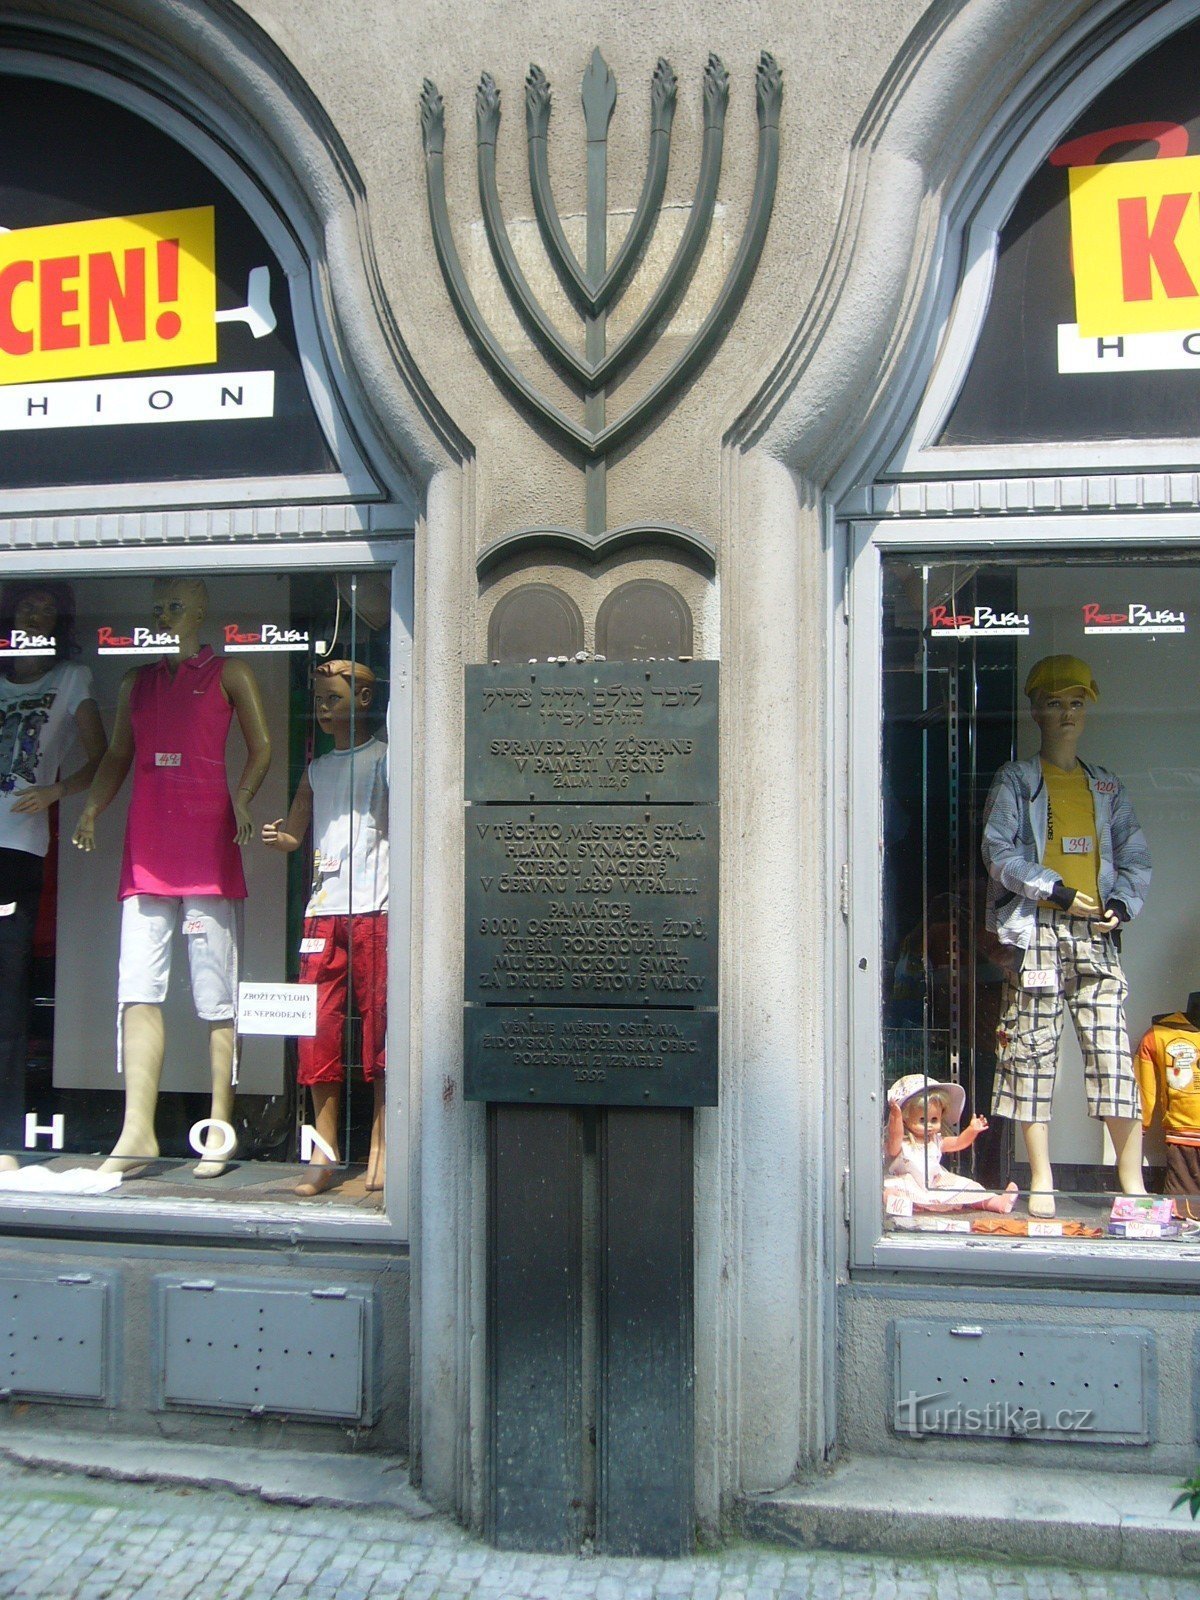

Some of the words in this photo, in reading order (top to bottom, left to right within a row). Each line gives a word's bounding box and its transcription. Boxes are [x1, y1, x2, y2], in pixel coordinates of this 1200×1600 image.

[490, 738, 607, 755] SPRAVEDLIVÝ
[614, 735, 693, 756] ZŮSTANE
[514, 758, 528, 773] V
[534, 756, 598, 773] PAMĚTI
[606, 754, 666, 773] VĚČNÉ
[553, 773, 593, 788] ŽALM
[598, 775, 630, 791] 112,6
[476, 823, 490, 840] V
[493, 820, 563, 840] TĚCHTO
[569, 820, 648, 841] MÍSTECH
[653, 820, 706, 841] STÁLA
[505, 838, 570, 858] HLAVNÍ
[577, 842, 680, 861] SYNAGOGA,
[513, 859, 583, 876] KTEROU
[592, 857, 667, 876] NACISTÉ
[480, 876, 494, 893] V
[498, 873, 569, 893] ČERVNU
[575, 876, 613, 894] 1939
[619, 874, 699, 894] VYPÁLILI
[548, 898, 632, 919] PAMÁTCE
[528, 918, 654, 937] OSTRAVSKÝCH
[662, 918, 709, 941] ŽIDŮ,
[502, 934, 553, 954] KTEŘÍ
[562, 937, 680, 955] PODSTOUPILI
[493, 952, 631, 972] MUČEDNICKOU
[639, 956, 690, 974] SMRT
[479, 972, 501, 989] ZA
[507, 969, 566, 990] DRUHÉ
[571, 970, 647, 991] SVĚTOVÉ
[652, 973, 706, 992] VÁLKY
[277, 992, 312, 1002] VÝLOHY
[243, 1009, 252, 1017] JE
[501, 1019, 556, 1034] VĚNUJE
[562, 1019, 611, 1036] MĚSTO
[482, 1033, 554, 1051] ŽIDOVSKÁ
[559, 1035, 654, 1052] NÁBOŽENSKÁ
[513, 1050, 590, 1067] POZŮSTALÍ
[593, 1053, 602, 1067] Z
[606, 1054, 664, 1068] IZRAELE
[573, 1069, 607, 1083] 1992
